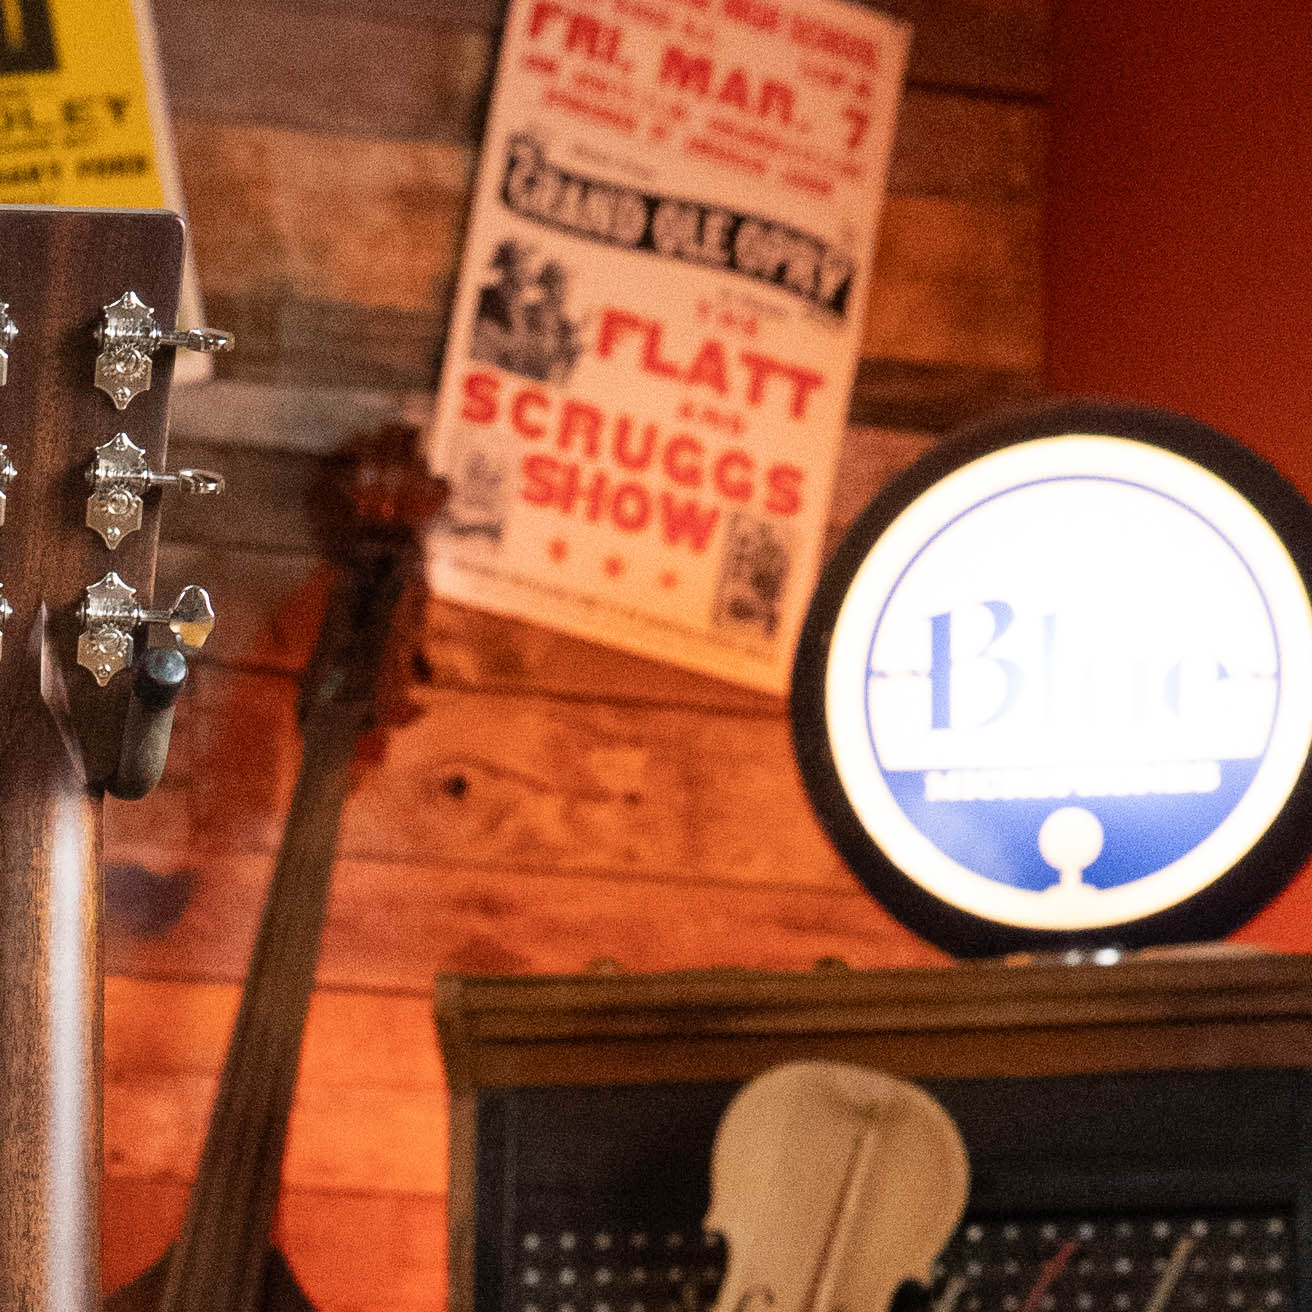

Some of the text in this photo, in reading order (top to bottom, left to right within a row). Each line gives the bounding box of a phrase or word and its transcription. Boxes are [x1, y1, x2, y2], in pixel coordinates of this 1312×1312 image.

[529, 0, 635, 75] FRI.
[658, 44, 811, 135] MAR.
[842, 106, 870, 150] 7
[596, 306, 827, 422] FLATT
[458, 371, 806, 518] SCRUGGS
[519, 453, 721, 555] SHOW
